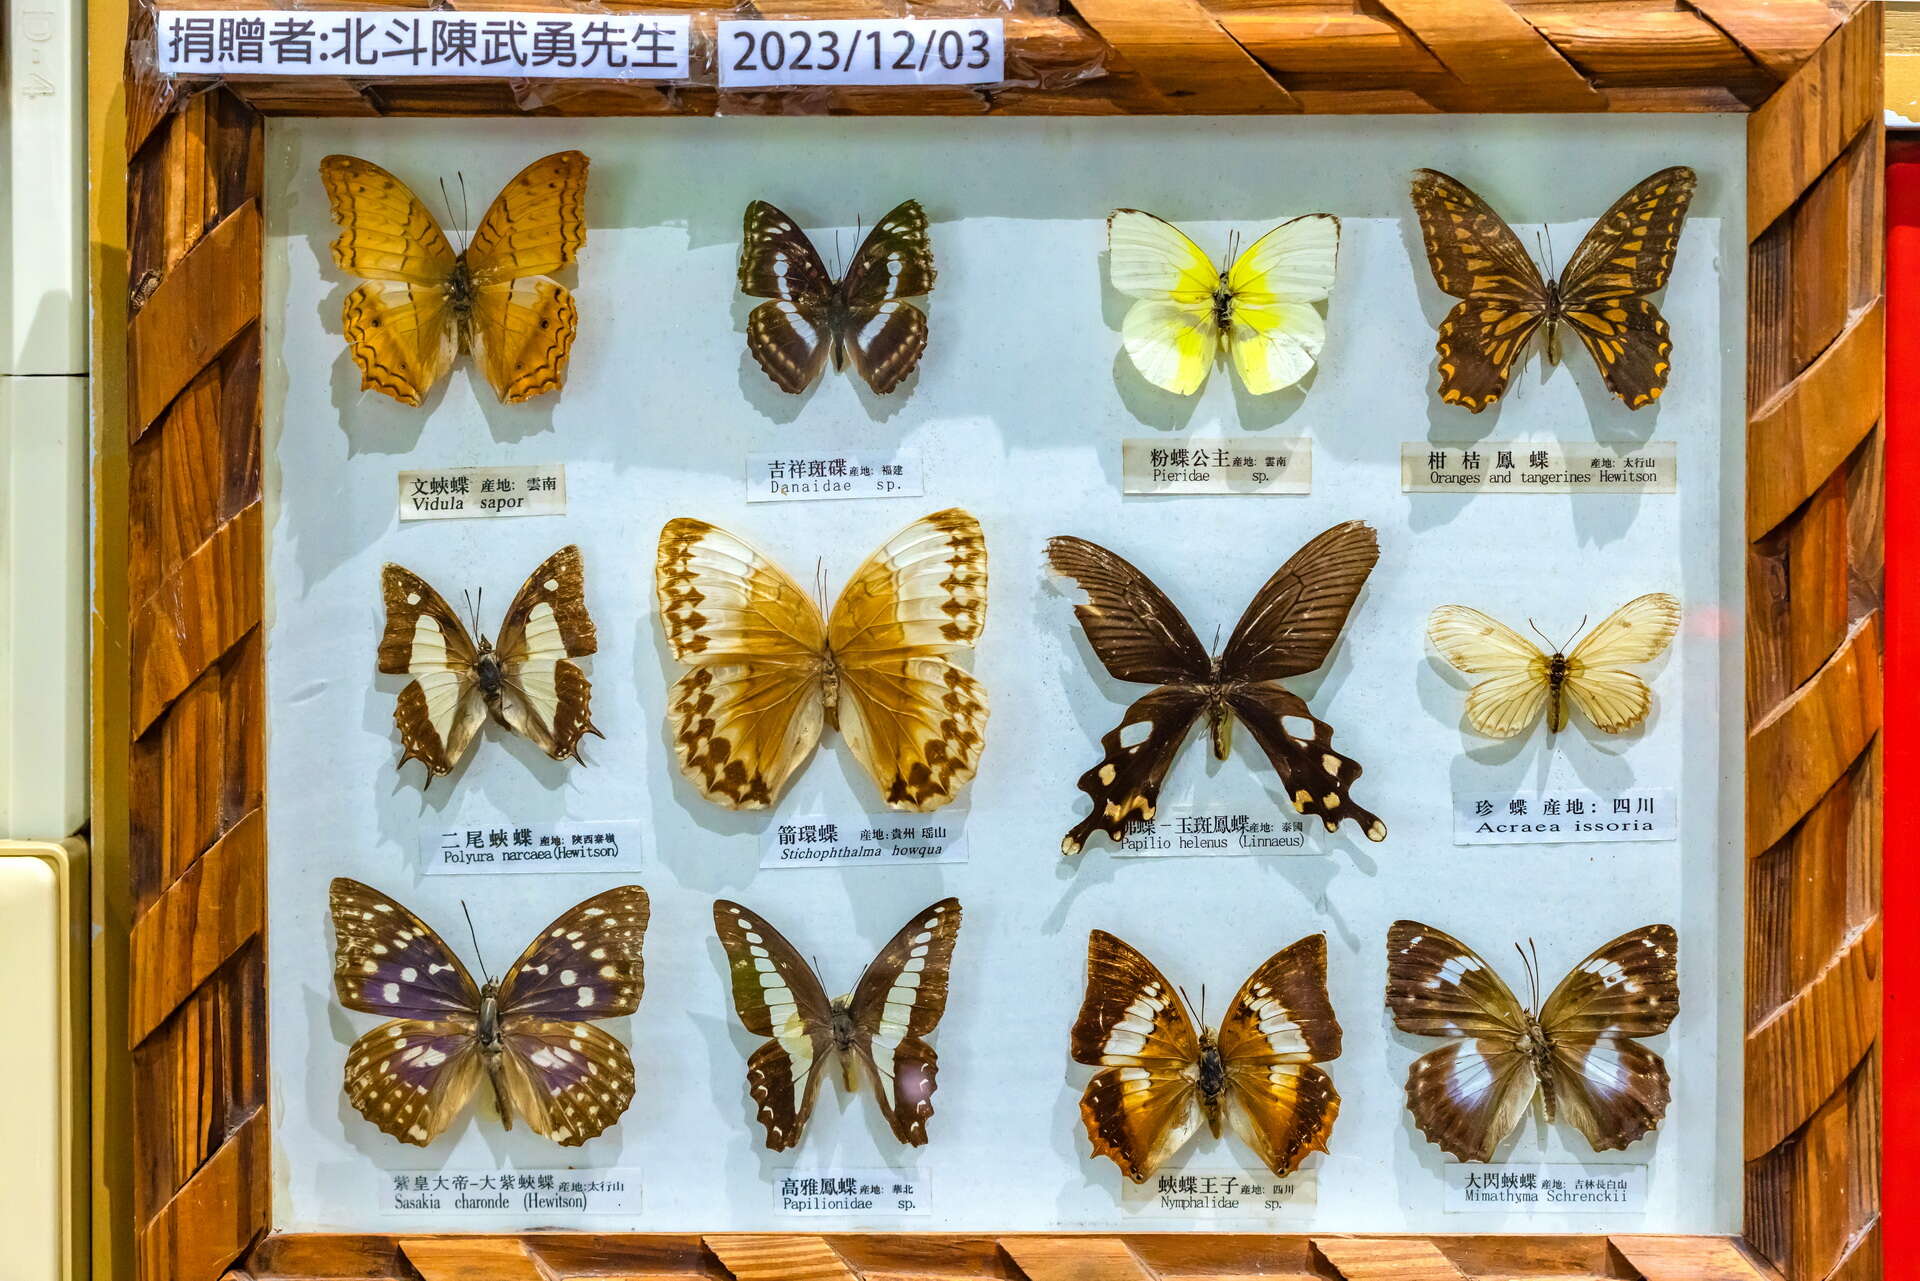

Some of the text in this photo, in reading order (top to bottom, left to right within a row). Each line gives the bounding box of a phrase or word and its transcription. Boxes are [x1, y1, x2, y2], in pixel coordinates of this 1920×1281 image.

[169, 17, 678, 69] 捐贈者:北斗陳武勇先生
[733, 29, 990, 72] 2023/12/03
[1150, 449, 1230, 468] 粉蝶公主
[1624, 457, 1655, 468] 太行山
[527, 477, 556, 491] 雲南
[1153, 469, 1269, 483] Pieridae sp.
[1430, 470, 1657, 485] Oranges and tangerines Hewitson
[771, 480, 902, 494] Danaidae sp.
[413, 496, 524, 512] Vidula sapor
[1475, 819, 1654, 833] Acraea issoria
[778, 824, 838, 845] 箭環蝶
[1121, 832, 1305, 851] Papilio helenus (Linnaeus)
[444, 850, 494, 865] Polyura
[781, 845, 942, 862] Stichophthalma howqua
[781, 1177, 857, 1196] 高雅鳳蝶
[1158, 1175, 1239, 1195] 蛺蝶王子
[1464, 1172, 1537, 1190] 大閃蛺蝶
[394, 1191, 587, 1212] Sasakia charonde (Hewitson)
[784, 1197, 916, 1211] Papilionidae sp.
[1161, 1196, 1282, 1211] Nymphalidae sp.
[1465, 1189, 1628, 1204] Mimathyma Schrenckii
